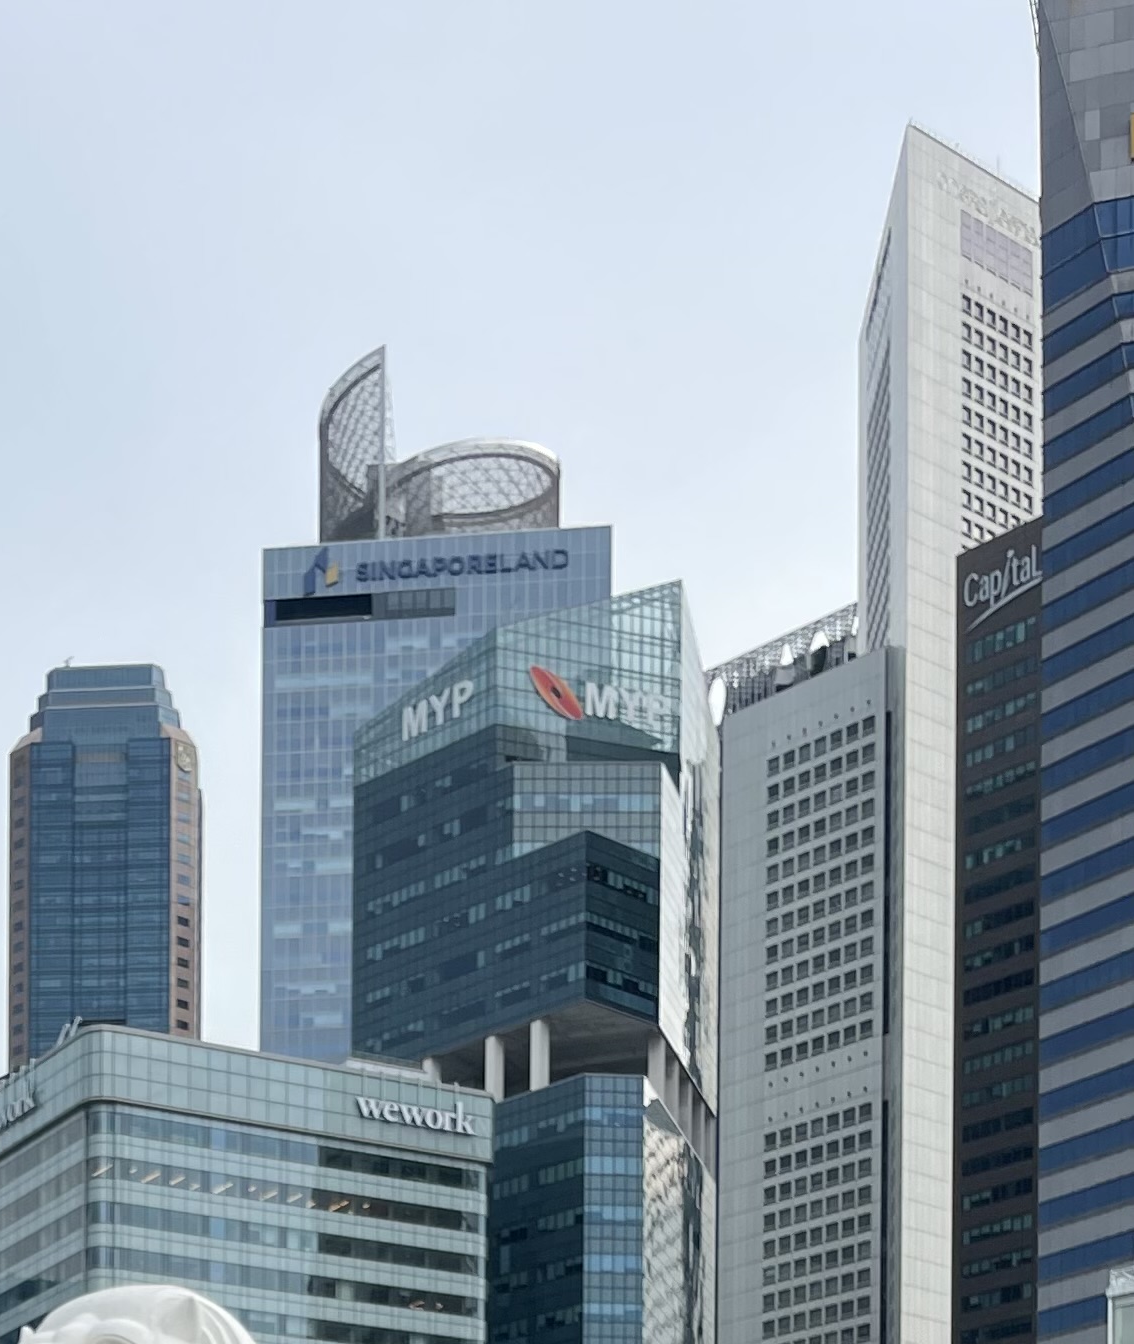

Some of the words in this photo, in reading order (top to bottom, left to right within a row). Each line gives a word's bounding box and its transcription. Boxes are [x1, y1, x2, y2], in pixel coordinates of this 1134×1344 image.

[355, 549, 569, 583] SINGAPORELAND
[401, 679, 474, 742] MYP
[584, 681, 669, 723] MYP
[355, 1096, 478, 1136] wework
